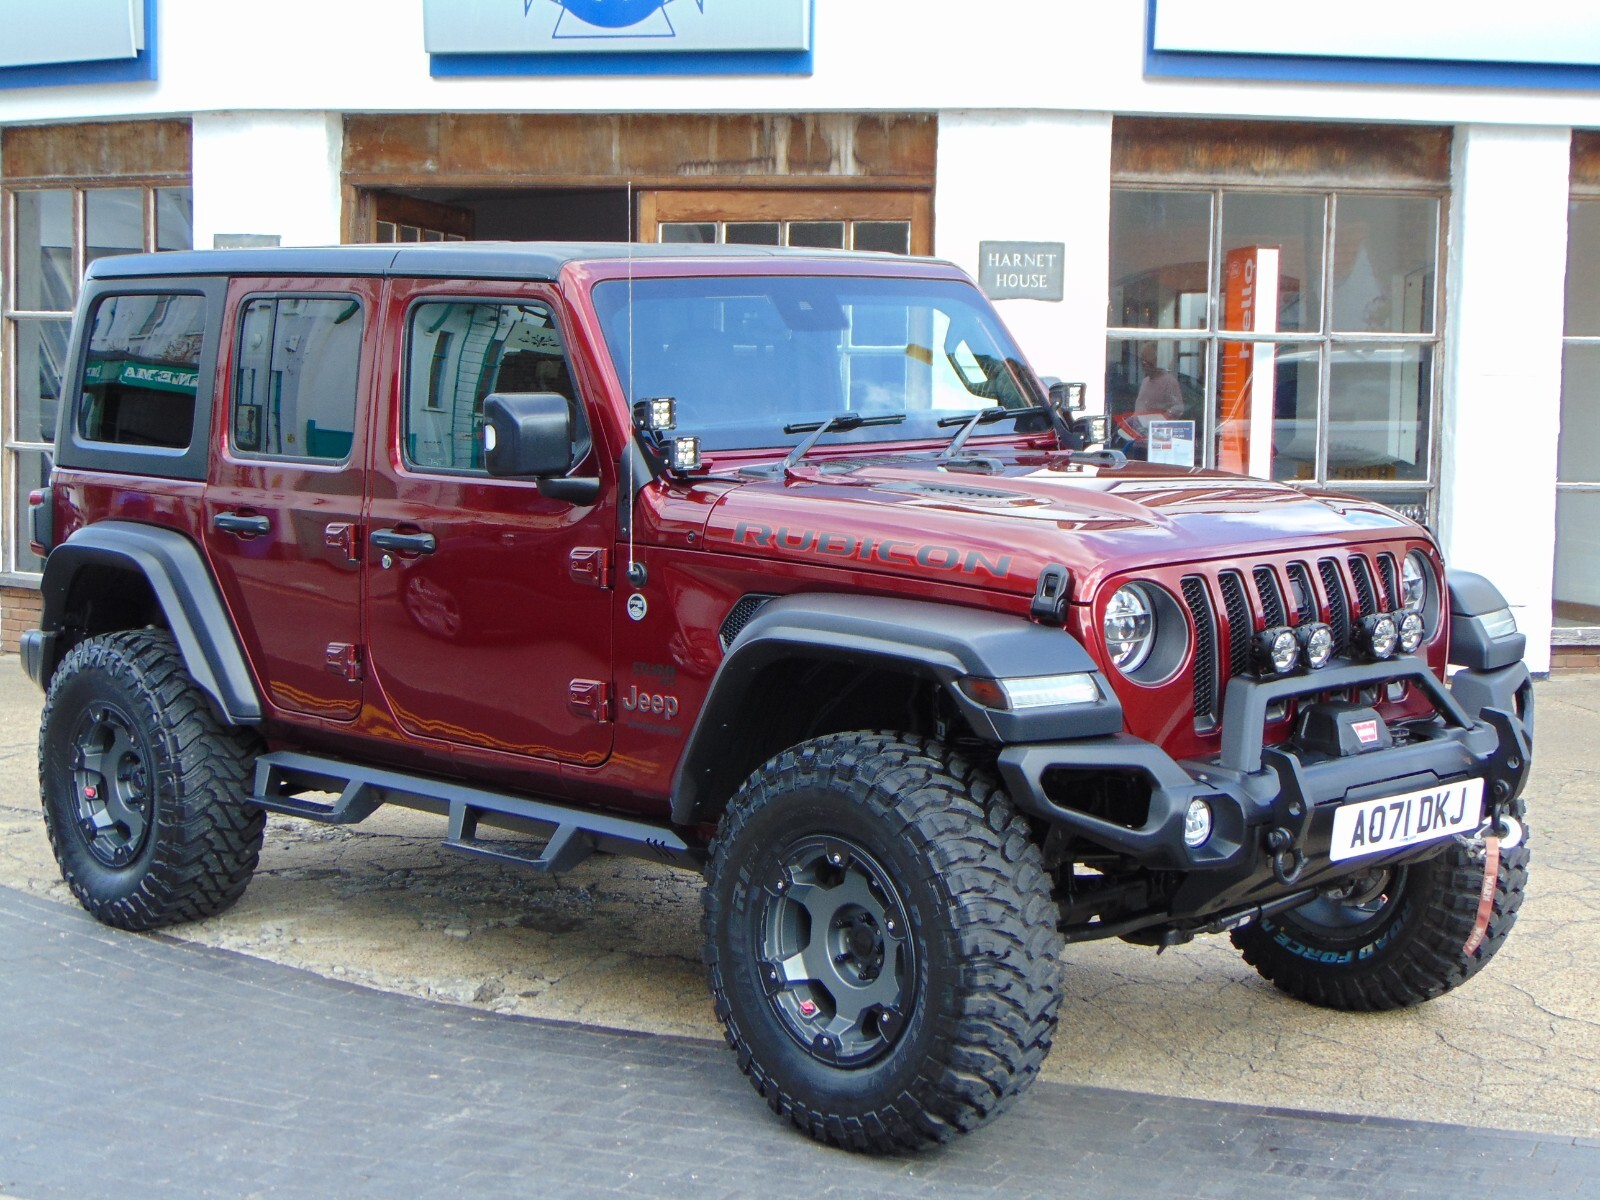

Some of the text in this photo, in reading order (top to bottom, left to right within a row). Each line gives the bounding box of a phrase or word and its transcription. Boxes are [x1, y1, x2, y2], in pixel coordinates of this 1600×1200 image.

[988, 252, 1057, 268] HARNET
[996, 273, 1048, 288] HOUSE
[731, 521, 1012, 579] RUBICON
[622, 685, 679, 721] Jeep
[1417, 787, 1467, 834] DKJ
[1274, 931, 1354, 965] FORCE
